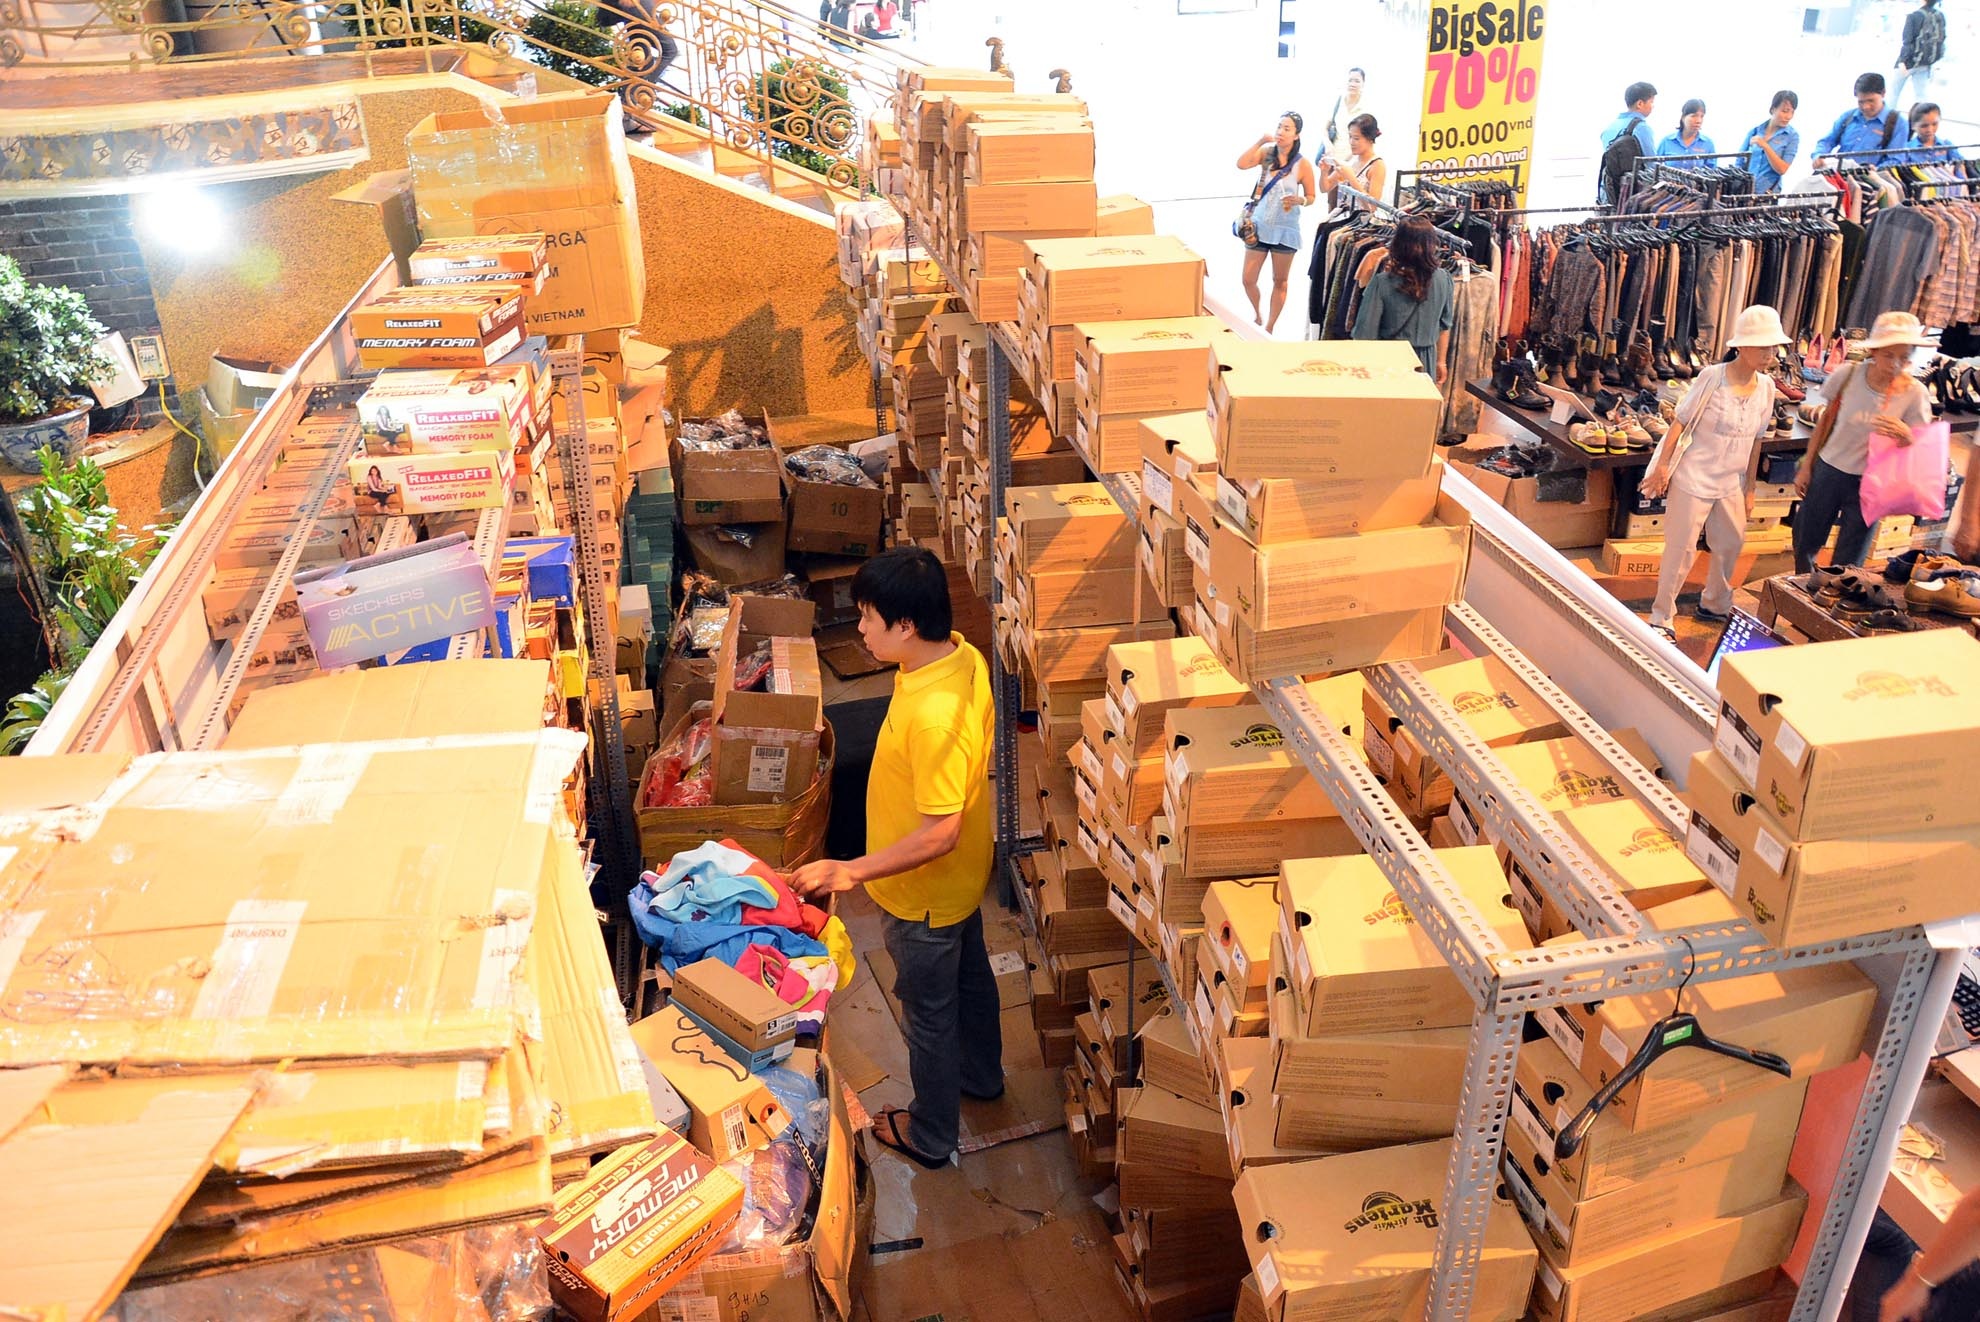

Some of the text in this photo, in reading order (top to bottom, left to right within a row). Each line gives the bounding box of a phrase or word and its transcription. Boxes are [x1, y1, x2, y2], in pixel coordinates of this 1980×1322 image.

[1429, 0, 1544, 57] BigSale
[1428, 44, 1536, 114] 70%
[422, 272, 525, 285] MEMORY FOAM
[532, 308, 586, 324] VIETNAM
[362, 338, 475, 348] MEMORY FOAM
[429, 432, 494, 442] MEMORY FOAM
[420, 490, 486, 502] MEMORY FOAM
[831, 502, 848, 516] 10
[327, 587, 425, 621] SKECHERS
[344, 591, 485, 644] ACTIVE
[553, 1149, 654, 1225] SKECHERS
[589, 1163, 699, 1260] MEMORY
[1344, 1198, 1435, 1234] Martens
[547, 1265, 577, 1290] OAM
